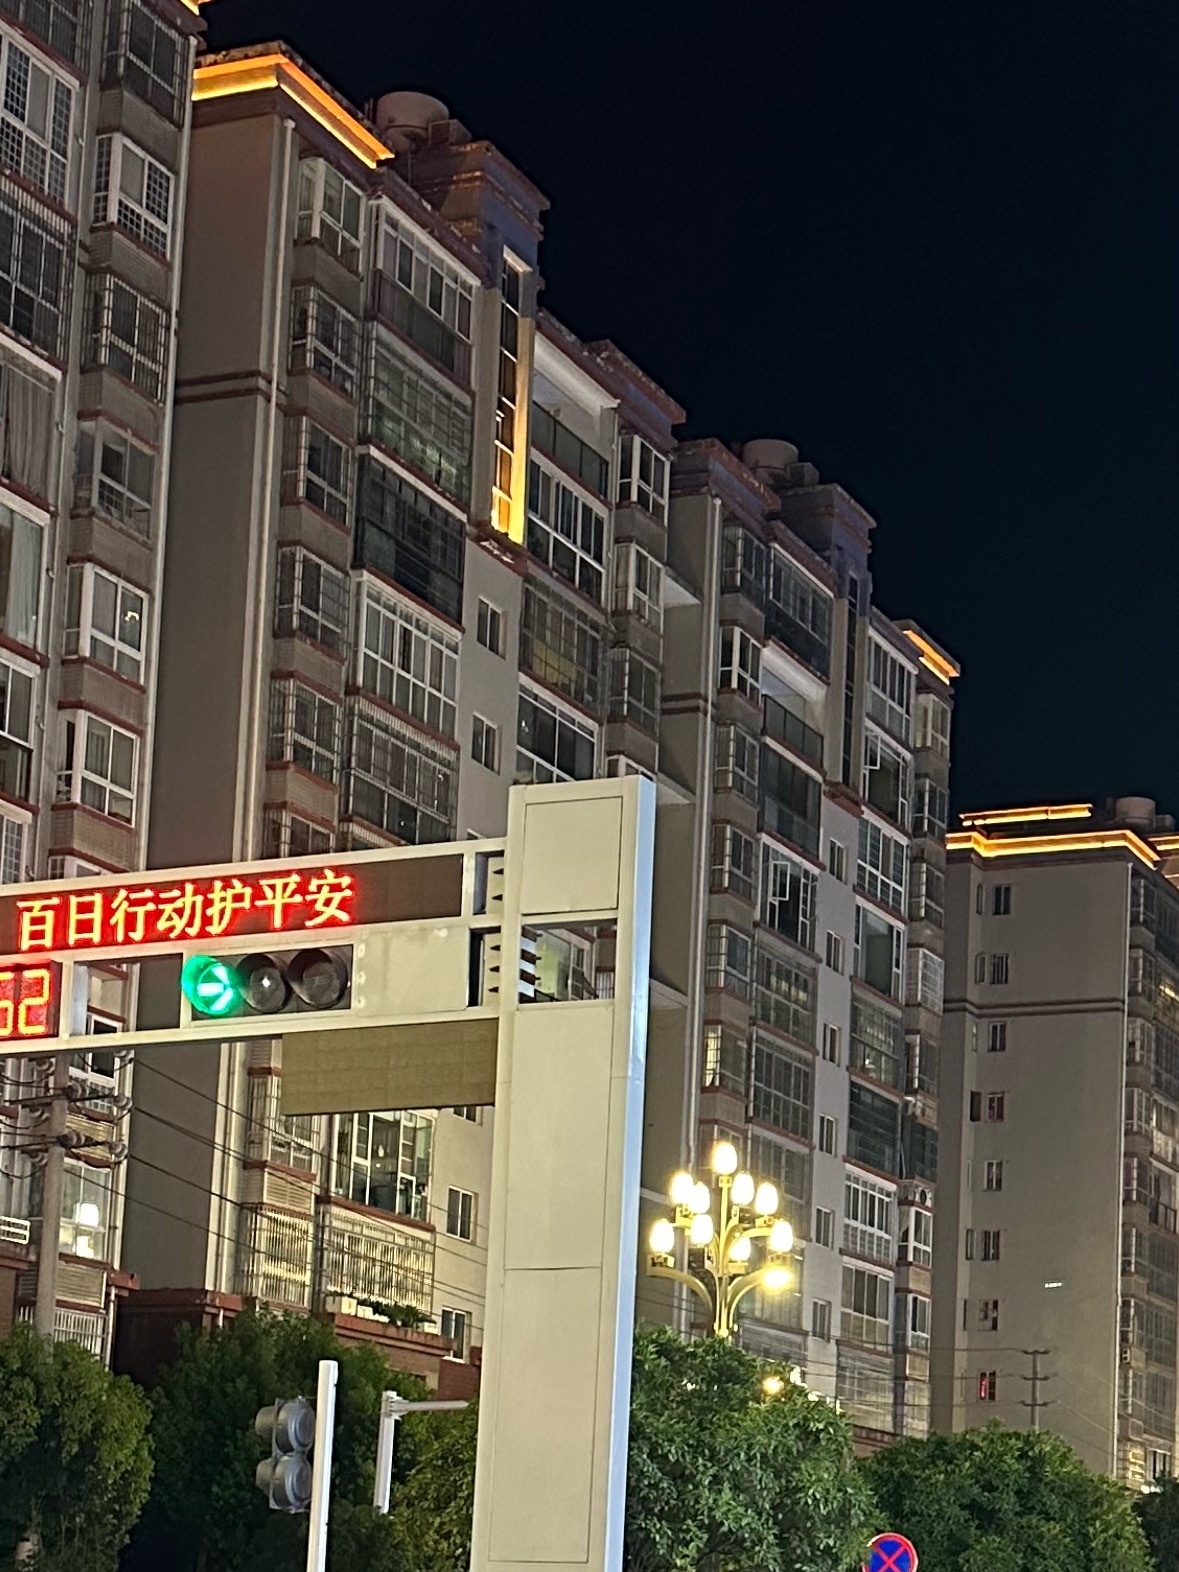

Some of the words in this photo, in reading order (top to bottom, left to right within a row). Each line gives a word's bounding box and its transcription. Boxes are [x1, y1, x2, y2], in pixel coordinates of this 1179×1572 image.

[16, 868, 356, 952] 百日行动护平安
